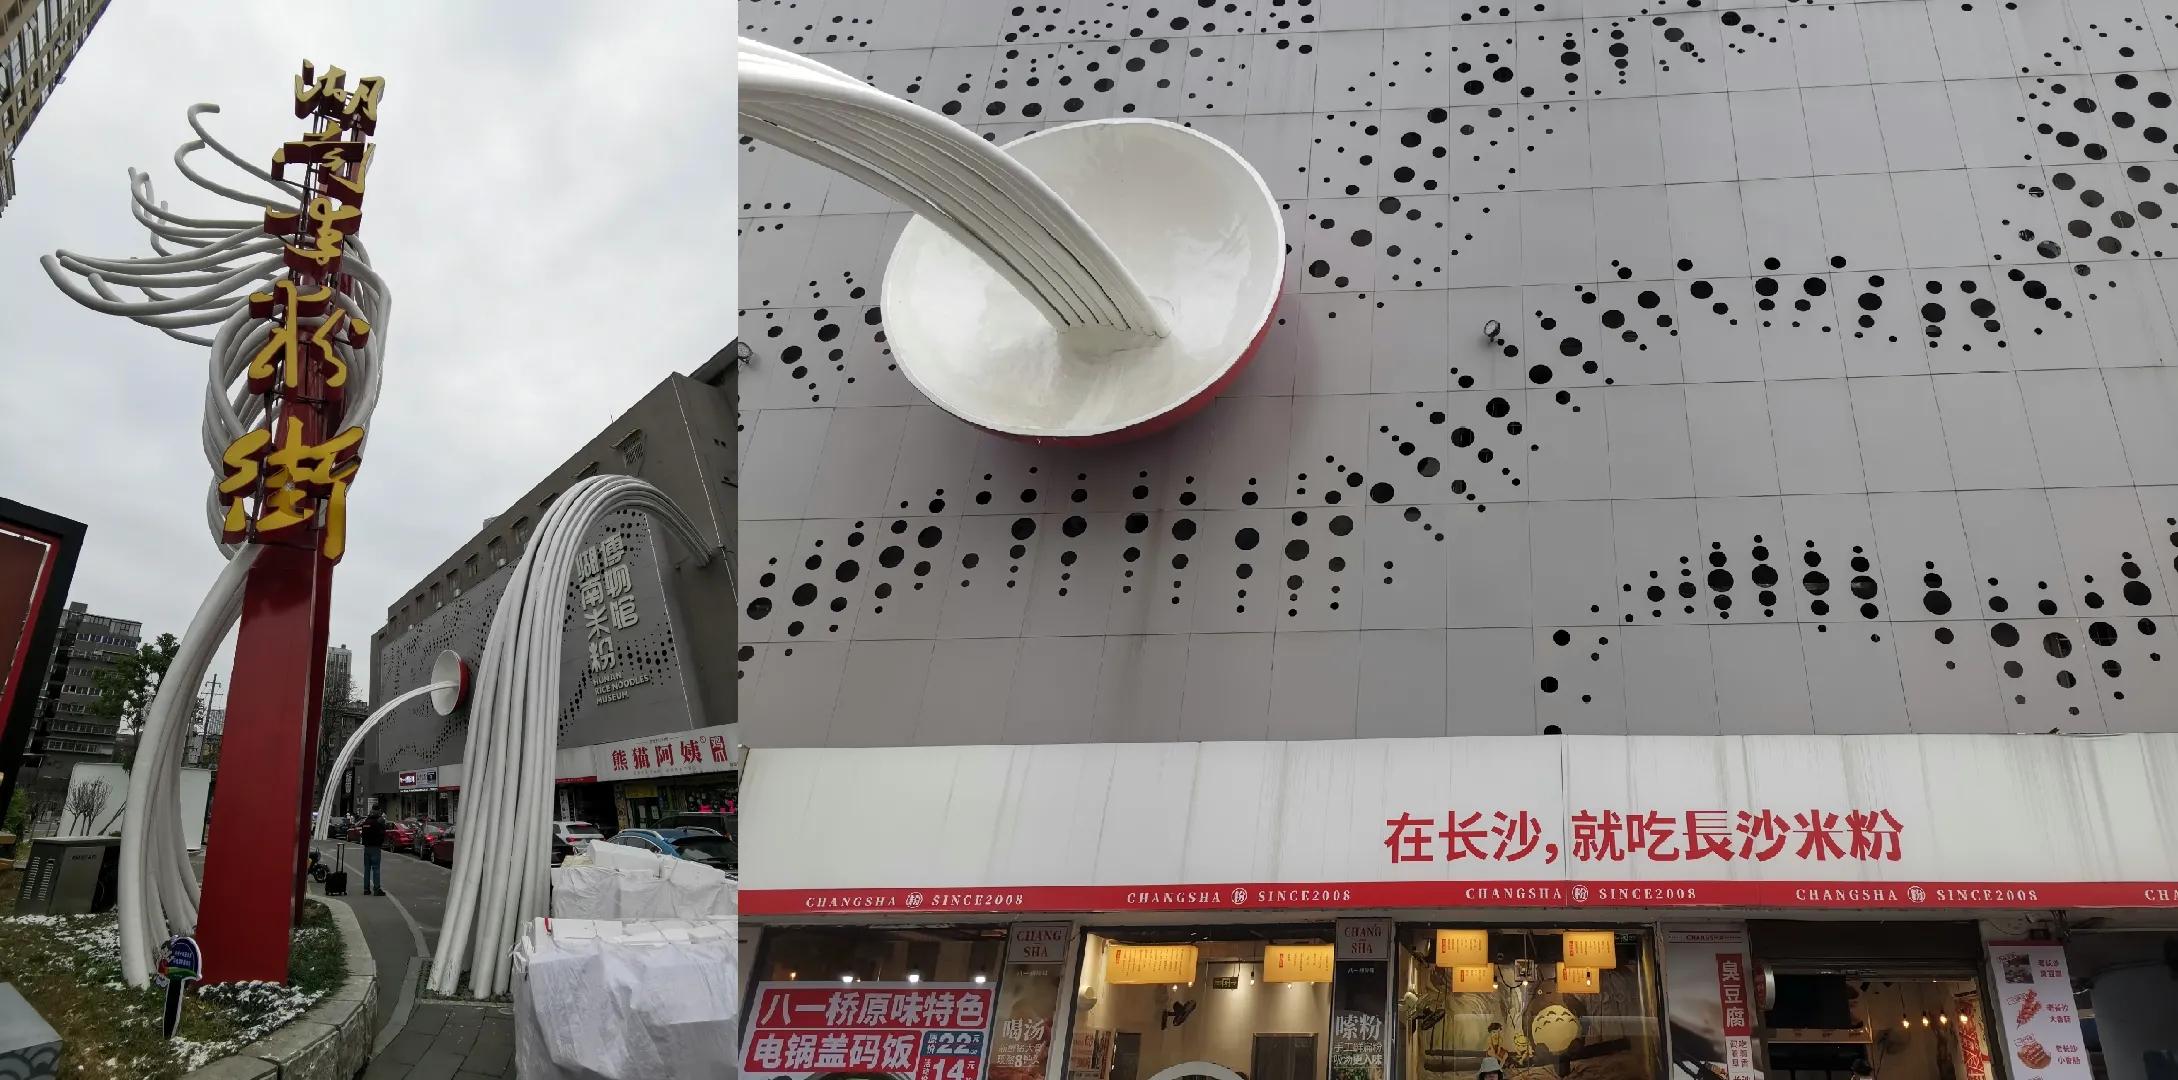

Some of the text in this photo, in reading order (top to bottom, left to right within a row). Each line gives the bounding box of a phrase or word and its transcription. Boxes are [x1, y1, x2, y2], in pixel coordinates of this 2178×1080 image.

[601, 533, 640, 630] 博物馆
[575, 545, 616, 673] 湖南米粉
[592, 672, 622, 687] HUNAN
[594, 674, 650, 696] RICE NOODLES
[596, 690, 629, 705] MUSEUM
[611, 739, 702, 771] 熊猫阿姨
[806, 895, 896, 908] CHANGSHA
[1127, 891, 1221, 904] CHANGSHA
[1465, 888, 1562, 900] CHANGSHA
[1796, 888, 1899, 901] CHANGSHA
[1016, 930, 1062, 943] CHANG
[1344, 926, 1382, 938] CHANG
[1023, 946, 1048, 958] SHA
[1351, 942, 1373, 954] SHA
[1722, 960, 1745, 1028] 臭豆腐
[760, 992, 985, 1028] 八一桥原味特色
[1002, 1018, 1045, 1042] 喝汤
[1335, 1015, 1382, 1041] 嗦粉
[753, 1033, 918, 1072] 电锅盖码饭
